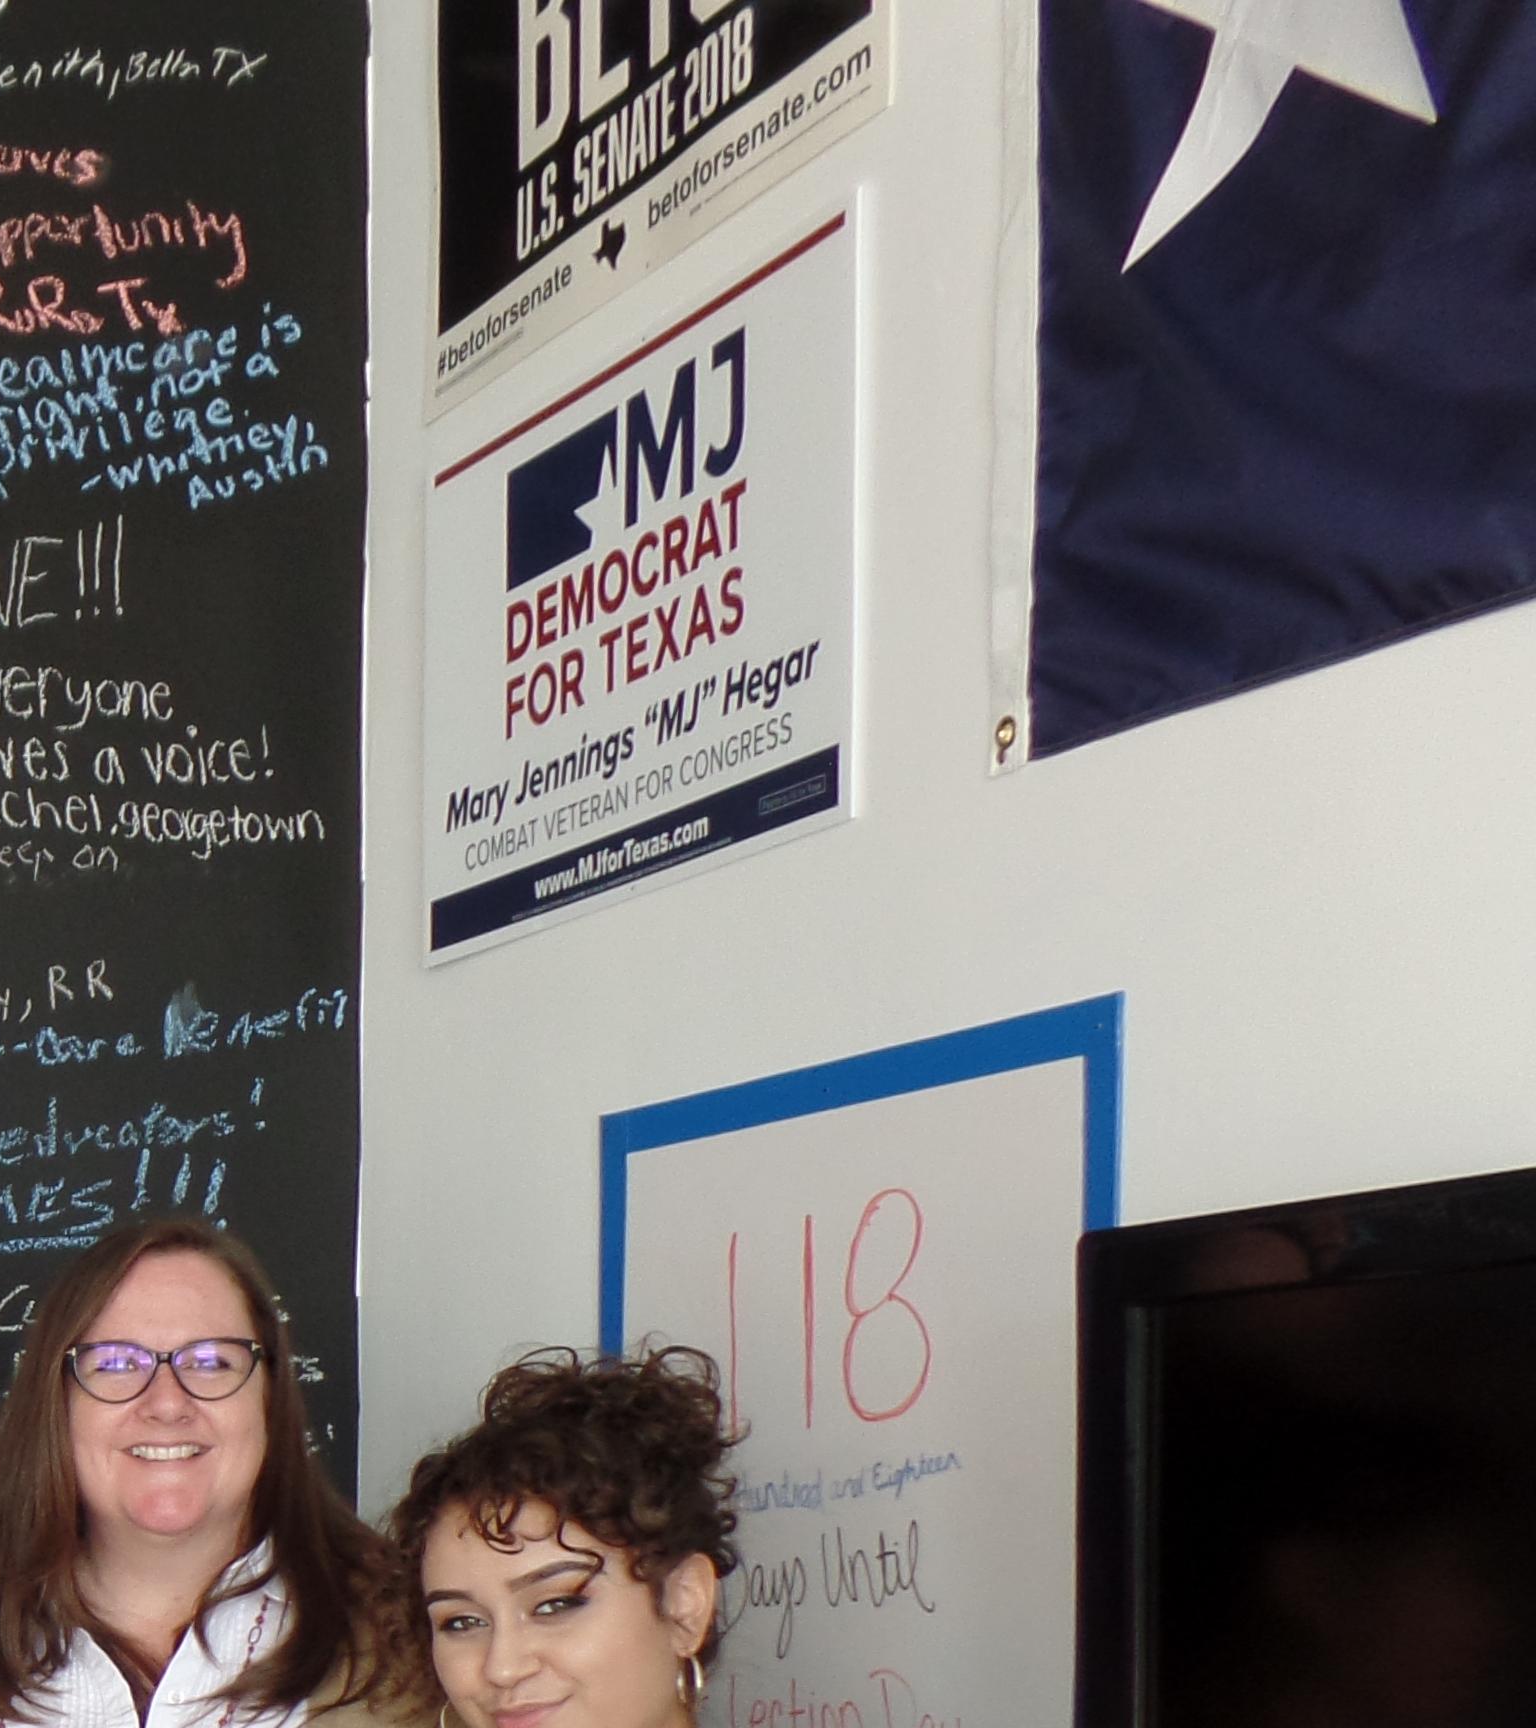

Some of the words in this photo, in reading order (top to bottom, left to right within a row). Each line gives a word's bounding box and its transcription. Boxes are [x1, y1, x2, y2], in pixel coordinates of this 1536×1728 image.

[435, 259, 573, 378] #betoforsenate
[647, 44, 872, 228] betoforsenate.com
[516, 159, 564, 261] U.S.
[572, 67, 677, 214] SENATE
[683, 8, 754, 134] 2018
[151, 357, 232, 406] not
[245, 352, 279, 378] a
[260, 301, 302, 348] is
[625, 325, 746, 530] MJ
[504, 659, 585, 741] FOR
[599, 565, 746, 693] TEXAS
[505, 478, 747, 666] DEMOCRAT
[94, 752, 127, 786] a
[140, 722, 275, 781] voice!
[444, 775, 510, 834] Mary
[515, 718, 635, 803] Jennings
[723, 638, 819, 716] Hegar
[465, 818, 538, 870] COMBAT
[540, 781, 629, 842] VETERAN
[635, 766, 673, 803] FOR
[679, 713, 793, 786] CONGRESS
[70, 844, 121, 873] on
[534, 816, 711, 899] www.MJforTexas.com
[727, 1187, 931, 1428] 118
[822, 1520, 935, 1612] Until
